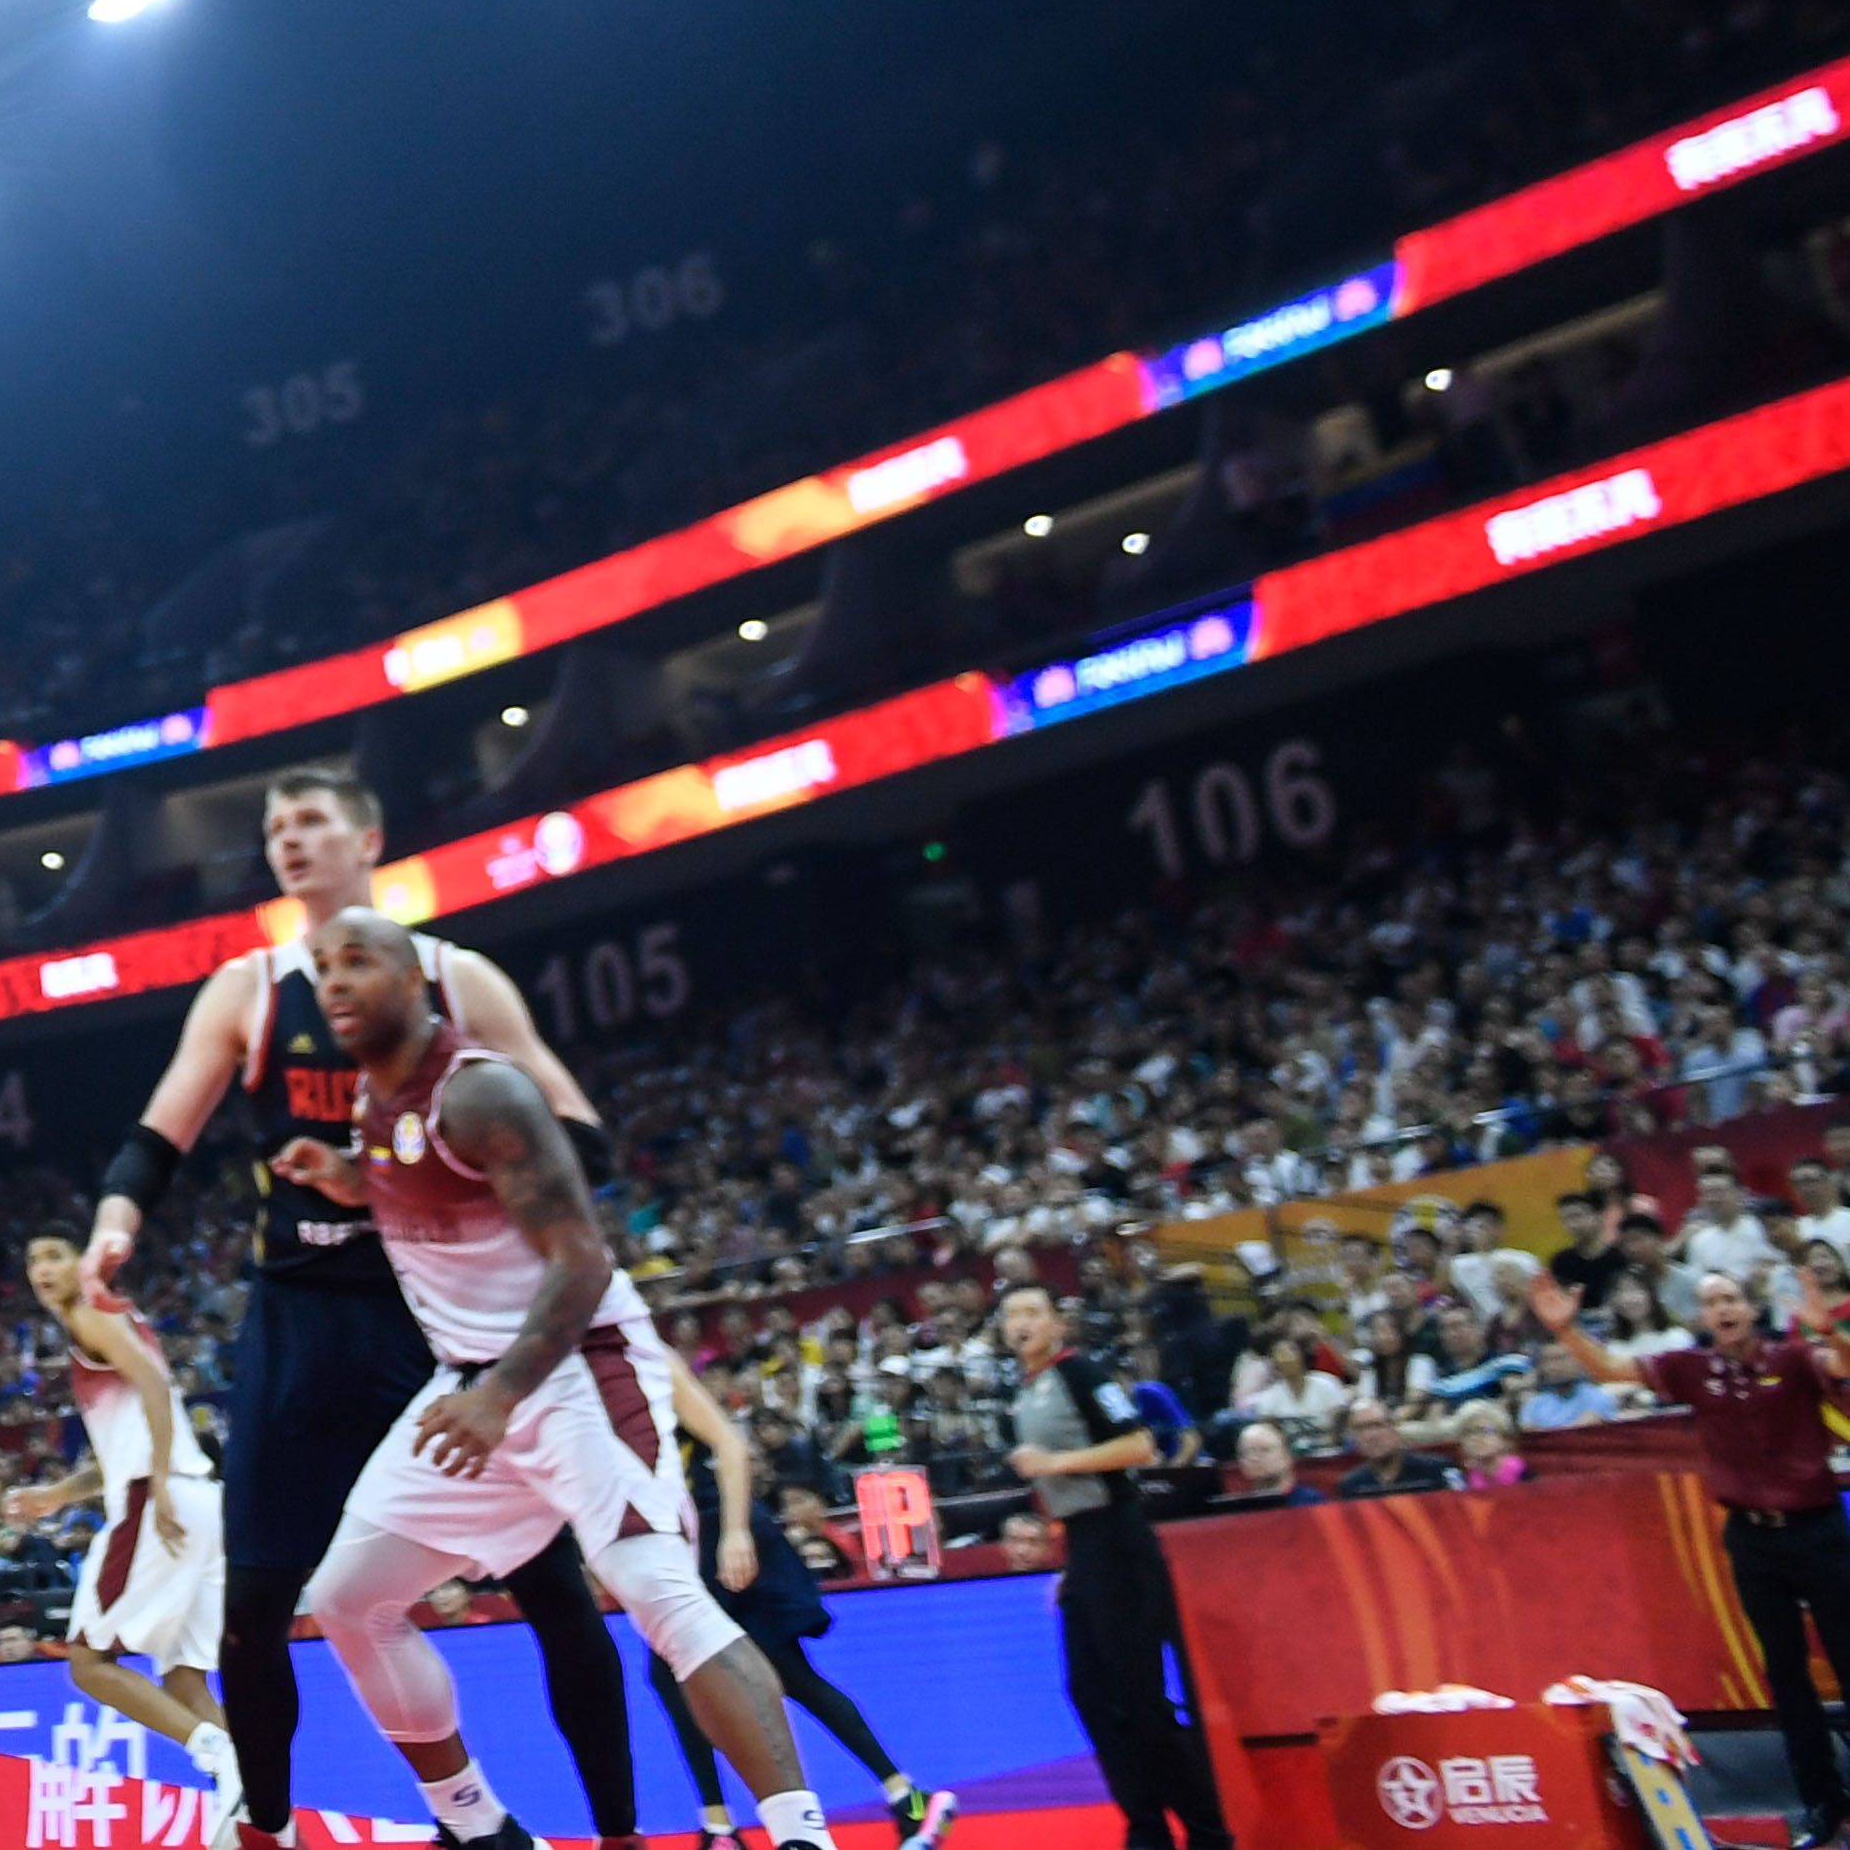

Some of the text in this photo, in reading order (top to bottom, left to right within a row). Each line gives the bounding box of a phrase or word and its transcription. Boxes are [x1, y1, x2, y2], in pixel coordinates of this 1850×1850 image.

[584, 253, 726, 349] 306
[241, 359, 366, 447] 305
[1125, 740, 1339, 881] 106
[536, 921, 694, 1042] 105
